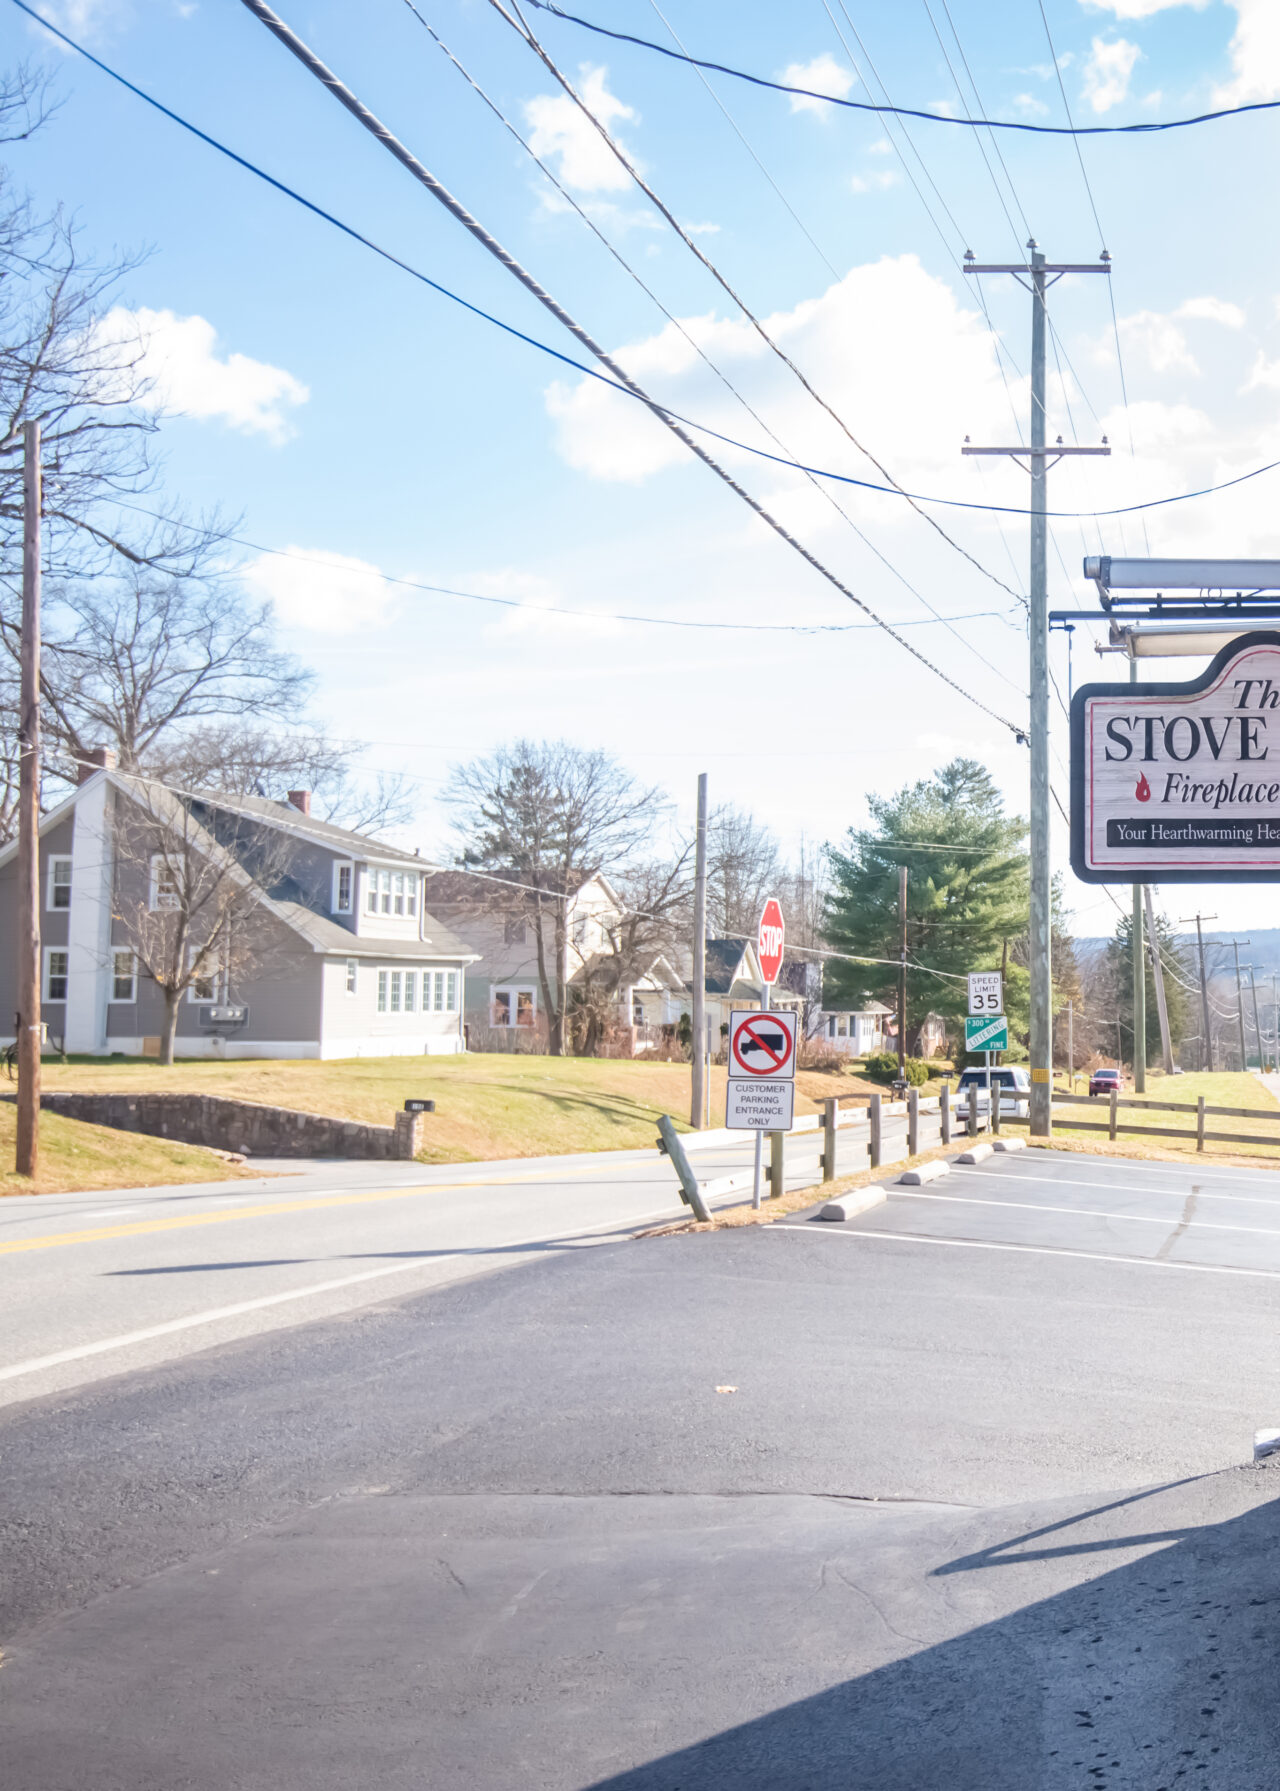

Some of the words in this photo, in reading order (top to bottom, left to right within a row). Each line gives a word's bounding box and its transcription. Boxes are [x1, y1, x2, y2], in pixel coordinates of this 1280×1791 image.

[1105, 716, 1269, 761] STOVE
[1161, 772, 1280, 809] Fireplace
[1117, 824, 1147, 840] Your
[1151, 823, 1253, 843] Hearthwarming
[760, 925, 783, 957] STOP
[971, 977, 999, 985] SPEED
[974, 985, 996, 993] LIMIT
[973, 994, 999, 1010] 35
[735, 1084, 786, 1093] CUSTOMER
[740, 1095, 780, 1104] PARKING
[735, 1106, 784, 1115] ENTRANCE
[747, 1117, 770, 1126] ONLY
